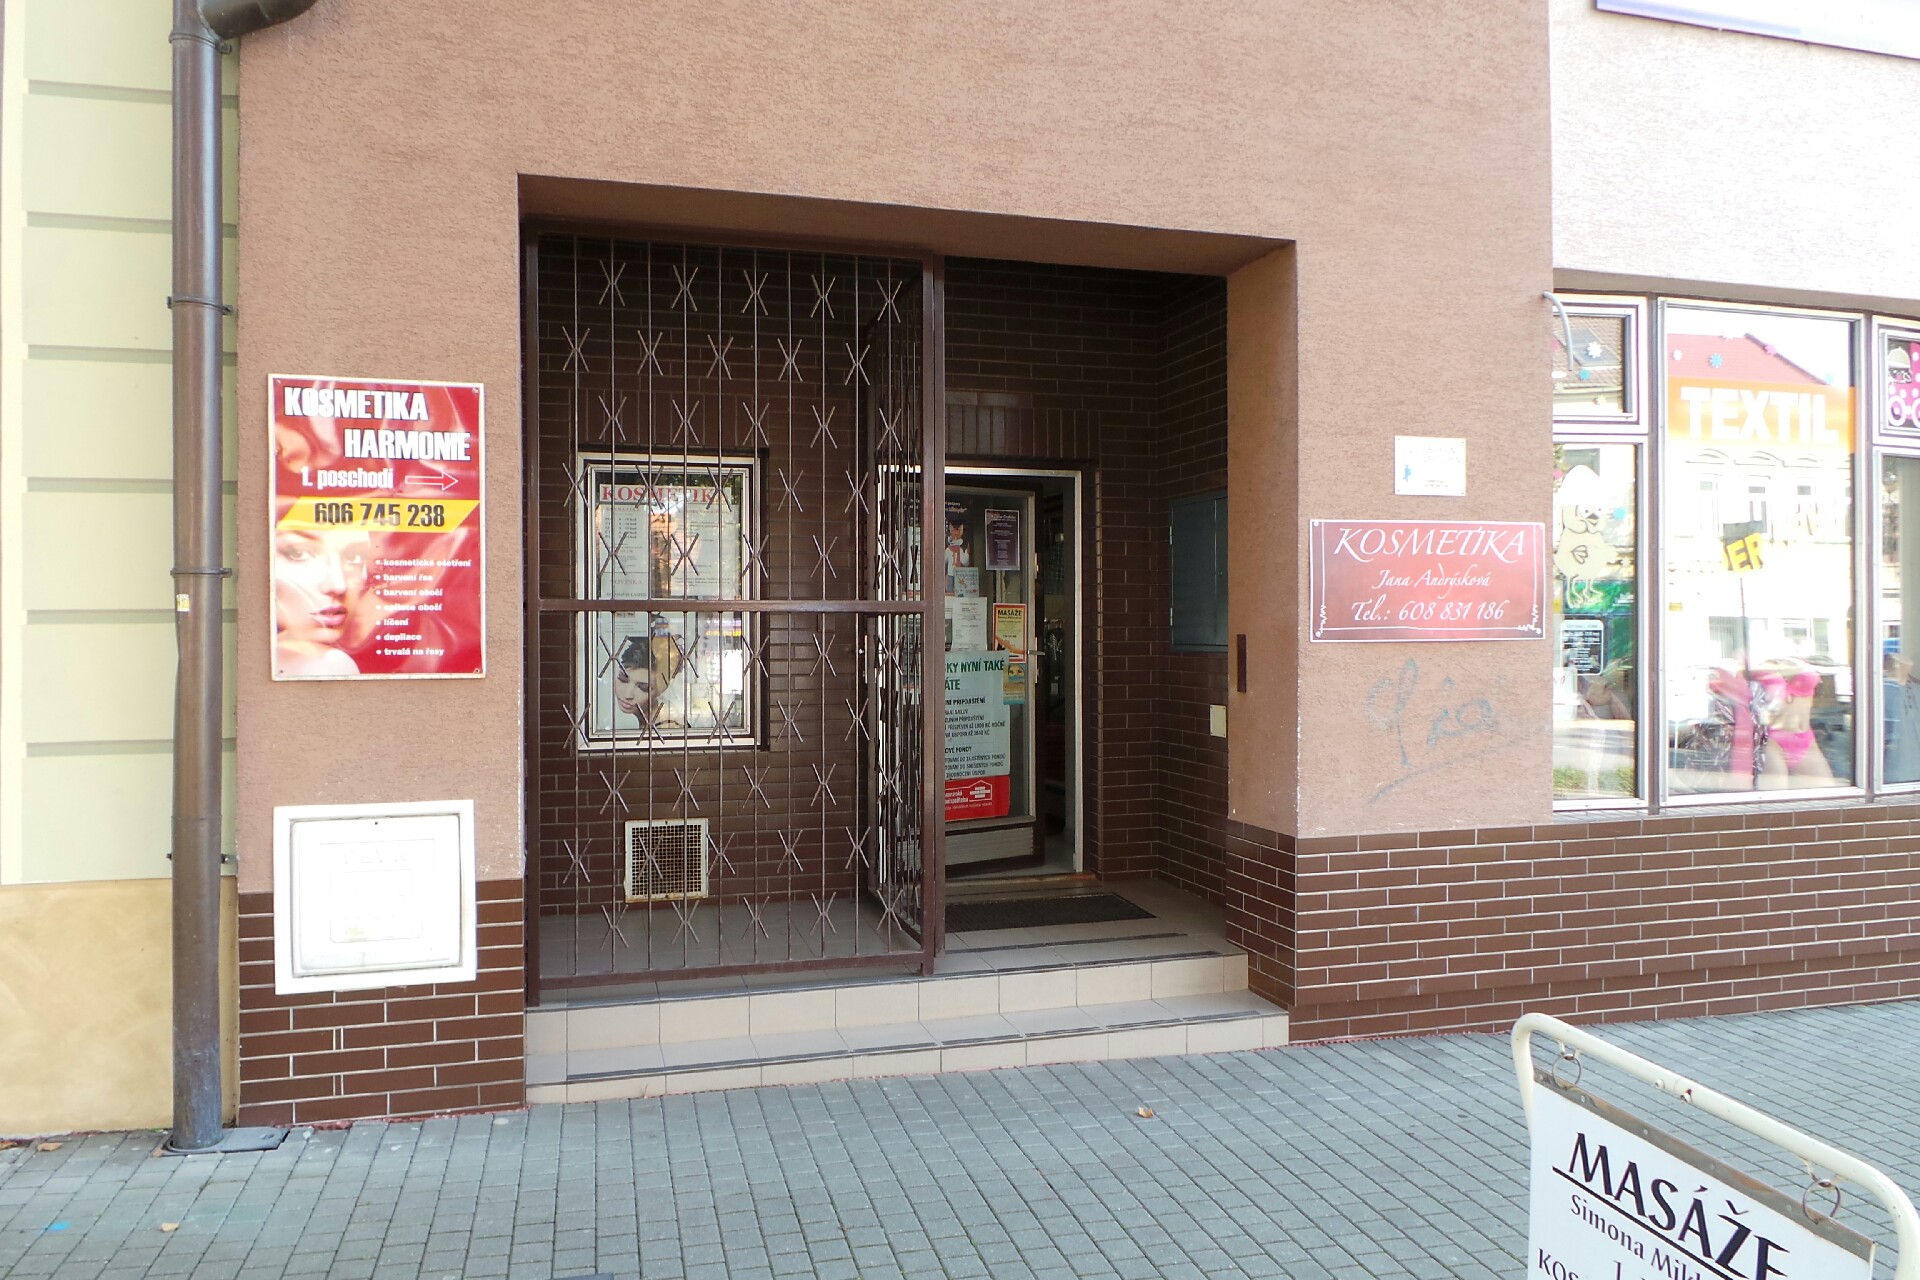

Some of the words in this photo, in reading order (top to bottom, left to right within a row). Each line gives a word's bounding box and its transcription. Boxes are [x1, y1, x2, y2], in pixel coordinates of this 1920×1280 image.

[284, 387, 428, 420] KOSMETIKA
[1681, 386, 1839, 443] TEXTIL
[344, 428, 471, 461] HARMONIE
[301, 466, 313, 486] 1.
[602, 486, 725, 504] KOSMETIK
[314, 502, 354, 525] 606
[360, 503, 400, 527] 745
[407, 504, 445, 527] 238
[1334, 526, 1525, 563] KOSMETIKA
[383, 559, 434, 567] kosmetické
[1372, 569, 1411, 589] Jana
[1414, 562, 1492, 599] Andrýsková
[418, 603, 442, 611] obočí
[1398, 601, 1436, 621] 608
[1440, 602, 1472, 621] 831
[1477, 600, 1510, 621] 186
[384, 618, 409, 626] líčení
[384, 633, 422, 642] depilace
[426, 648, 444, 656] řasy
[945, 663, 958, 673] KY
[961, 658, 982, 672] NYNÍ
[984, 657, 1005, 671] TAKÉ
[1569, 1132, 1790, 1280] MASÁŽE
[1571, 1194, 1645, 1260] Simona
